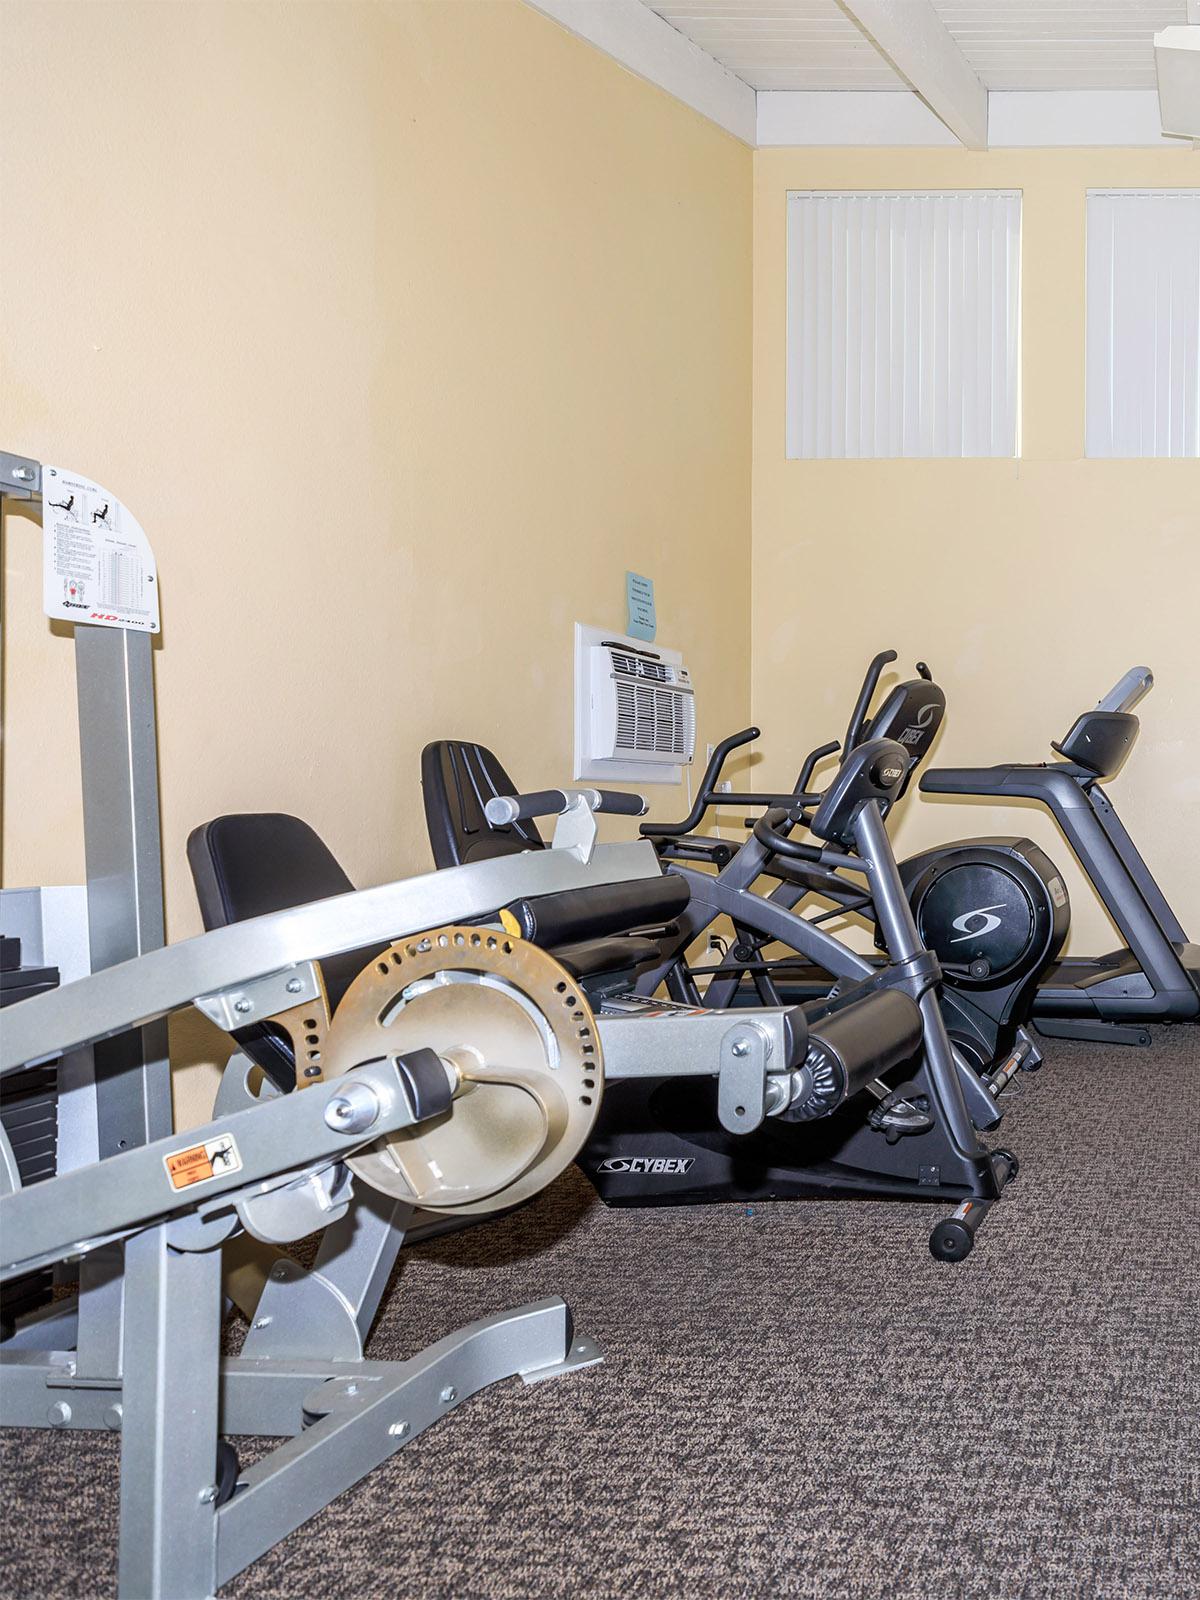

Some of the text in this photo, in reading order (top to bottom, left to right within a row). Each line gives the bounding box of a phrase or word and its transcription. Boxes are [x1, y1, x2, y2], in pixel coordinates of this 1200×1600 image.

[90, 612, 118, 621] HD
[897, 727, 925, 745] CYBEX
[629, 1158, 690, 1173] CYBEX
